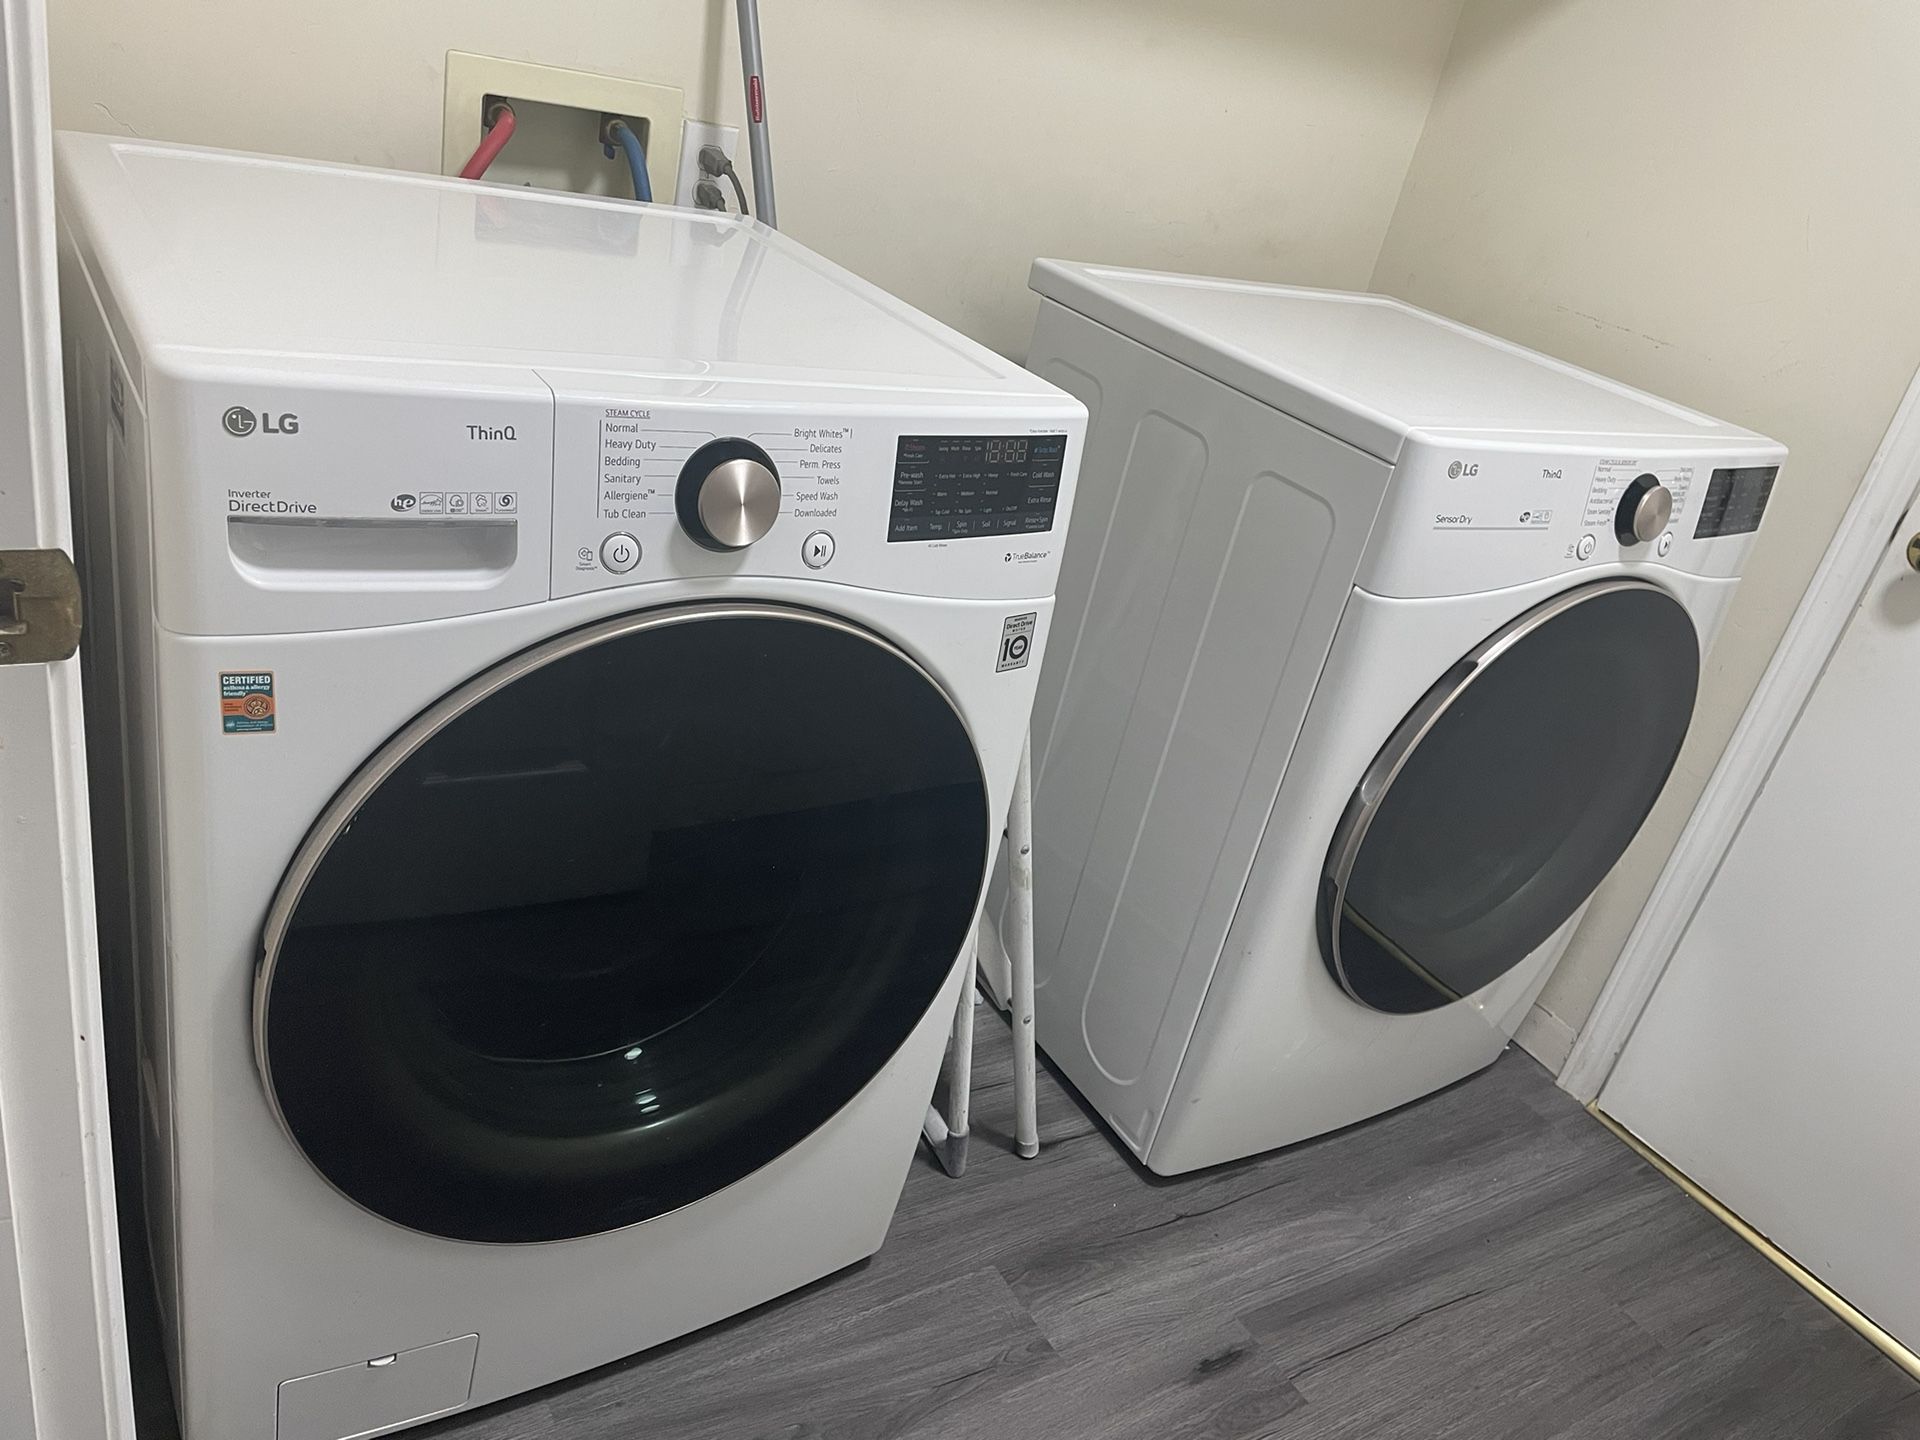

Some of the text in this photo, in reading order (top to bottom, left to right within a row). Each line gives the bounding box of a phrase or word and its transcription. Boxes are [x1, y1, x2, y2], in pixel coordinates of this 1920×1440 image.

[605, 409, 651, 419] STEAM CYCLE
[262, 413, 299, 434] LG
[605, 423, 639, 433] Normal
[466, 425, 517, 441] ThinQ
[794, 428, 817, 440] Bright
[604, 439, 657, 452] Heavy Duty
[809, 443, 842, 453] Delicates
[604, 456, 641, 469] Bedding
[800, 460, 841, 469] Perm. Press
[1032, 471, 1042, 479] Cold
[1462, 463, 1479, 477] LG
[1542, 469, 1562, 479] ThinQ
[604, 473, 641, 486] Sanitary
[817, 475, 840, 485] Towels
[228, 489, 271, 499] Inverter
[796, 491, 839, 502] Speed Wash
[603, 508, 646, 519] Tub Clean
[794, 508, 837, 518] Downloaded
[1002, 635, 1028, 661] 10
[223, 675, 271, 685] CERTIFIED
